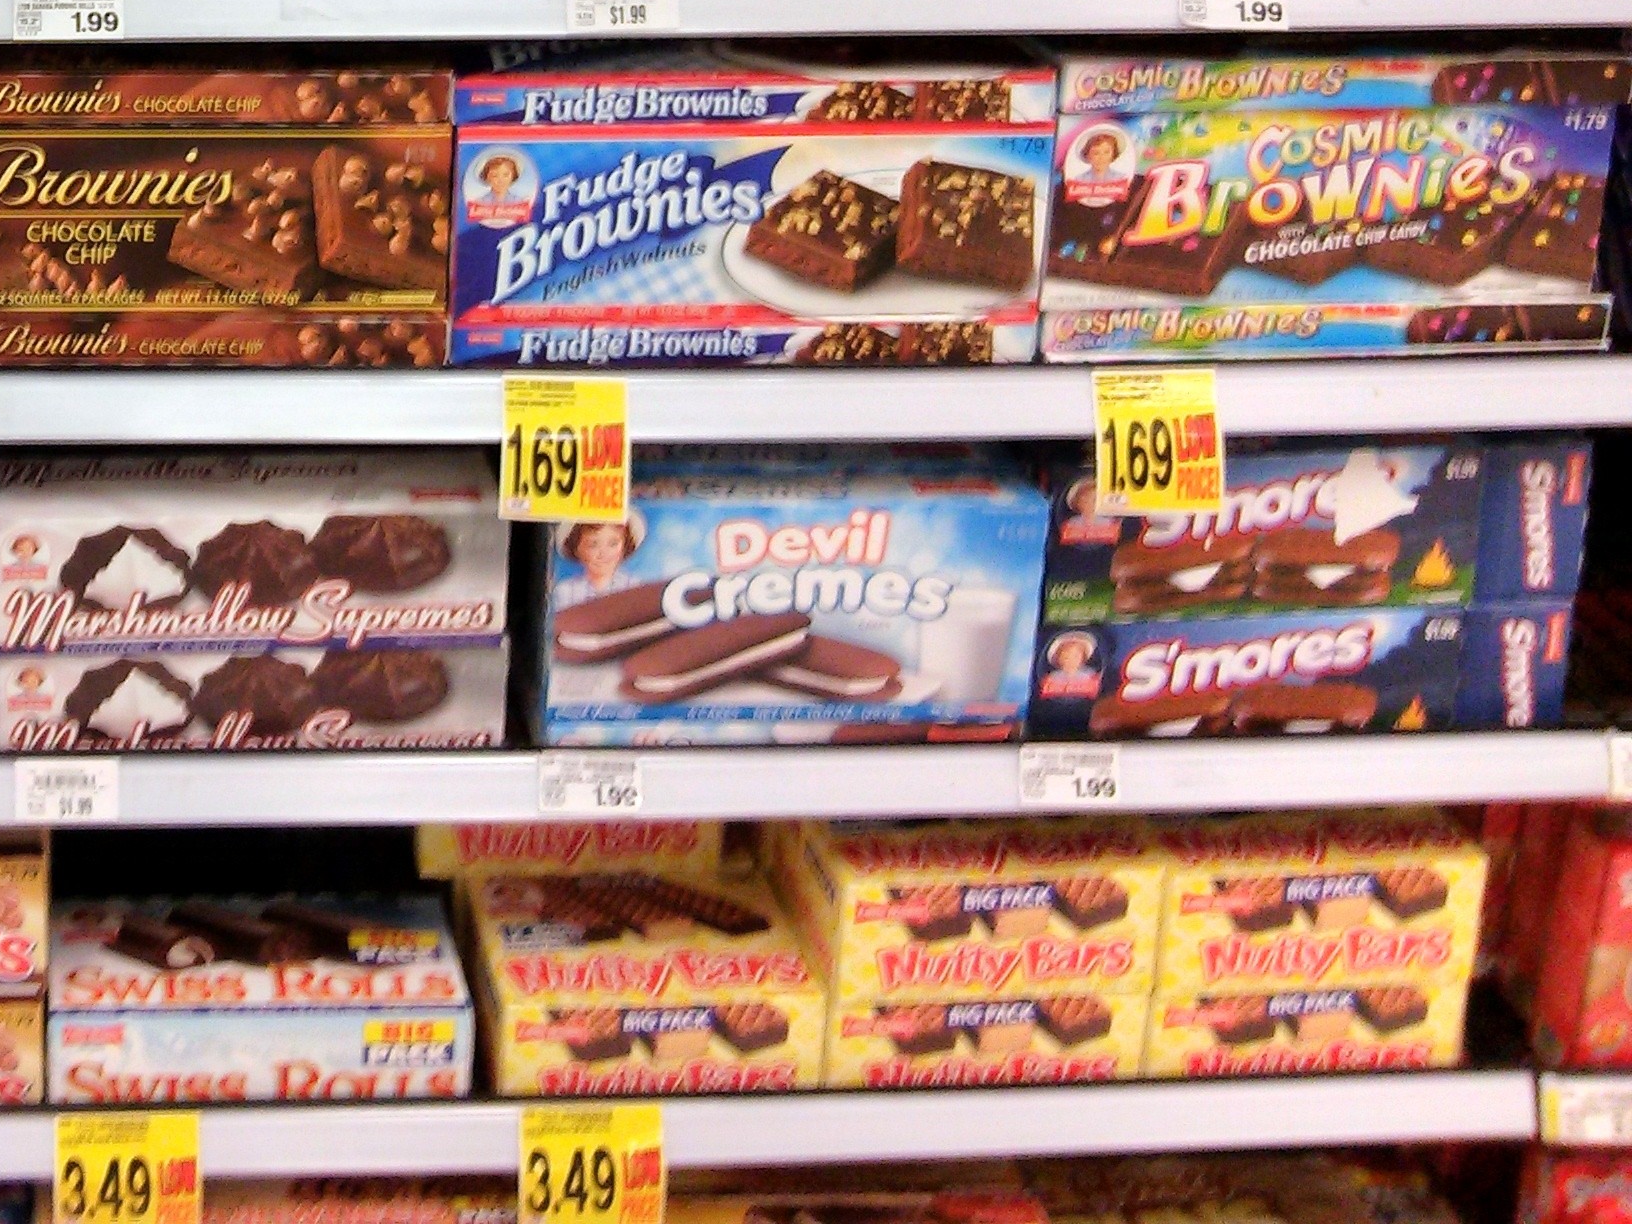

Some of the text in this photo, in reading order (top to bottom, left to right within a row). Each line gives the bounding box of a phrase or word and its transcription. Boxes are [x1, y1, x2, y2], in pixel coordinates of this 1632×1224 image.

[69, 12, 119, 33] 1.99
[609, 5, 647, 25] $1.99
[1234, 2, 1283, 24] 1.99
[133, 97, 223, 114] CHOCOLATE
[226, 97, 262, 113] CHIP
[519, 87, 768, 125] Fudge Brownies
[1564, 112, 1606, 132] $1.79
[543, 149, 690, 226] Fudge
[27, 222, 158, 243] CHOCOLATE
[492, 176, 763, 306] Brownies
[1244, 220, 1427, 264] CHOCOLATE CHIP CANDY
[65, 244, 117, 265] CHIP
[541, 239, 708, 302] English Walnuts
[7, 293, 145, 305] SQUARES PACKAGES
[139, 343, 226, 356] CHOCOLATE
[230, 341, 264, 355] CHIP
[518, 328, 758, 364] Fudge Brownies
[581, 423, 625, 472] LOW
[1101, 417, 1173, 492] 1.69
[1173, 413, 1216, 463] LOW
[506, 423, 578, 499] 1.69
[579, 474, 624, 511] PRICE!
[1176, 465, 1219, 501] PRICE!
[716, 510, 893, 570] Devil
[3, 578, 494, 653] Marshmallow Supremes
[661, 569, 954, 628] Cremes
[1121, 622, 1375, 702] S'mores
[1071, 776, 1116, 798] 1.99
[964, 885, 1053, 910] BIG PACK
[1286, 876, 1369, 903] BIG PACK
[877, 935, 1134, 989] Nutty Bars
[1201, 927, 1452, 985] Nutty Bars
[60, 969, 248, 1007] Swiss
[1268, 991, 1355, 1016] BIG PACK
[982, 1001, 1036, 1024] PACK
[59, 1156, 154, 1219] 3.49
[524, 1145, 618, 1215] 3.49
